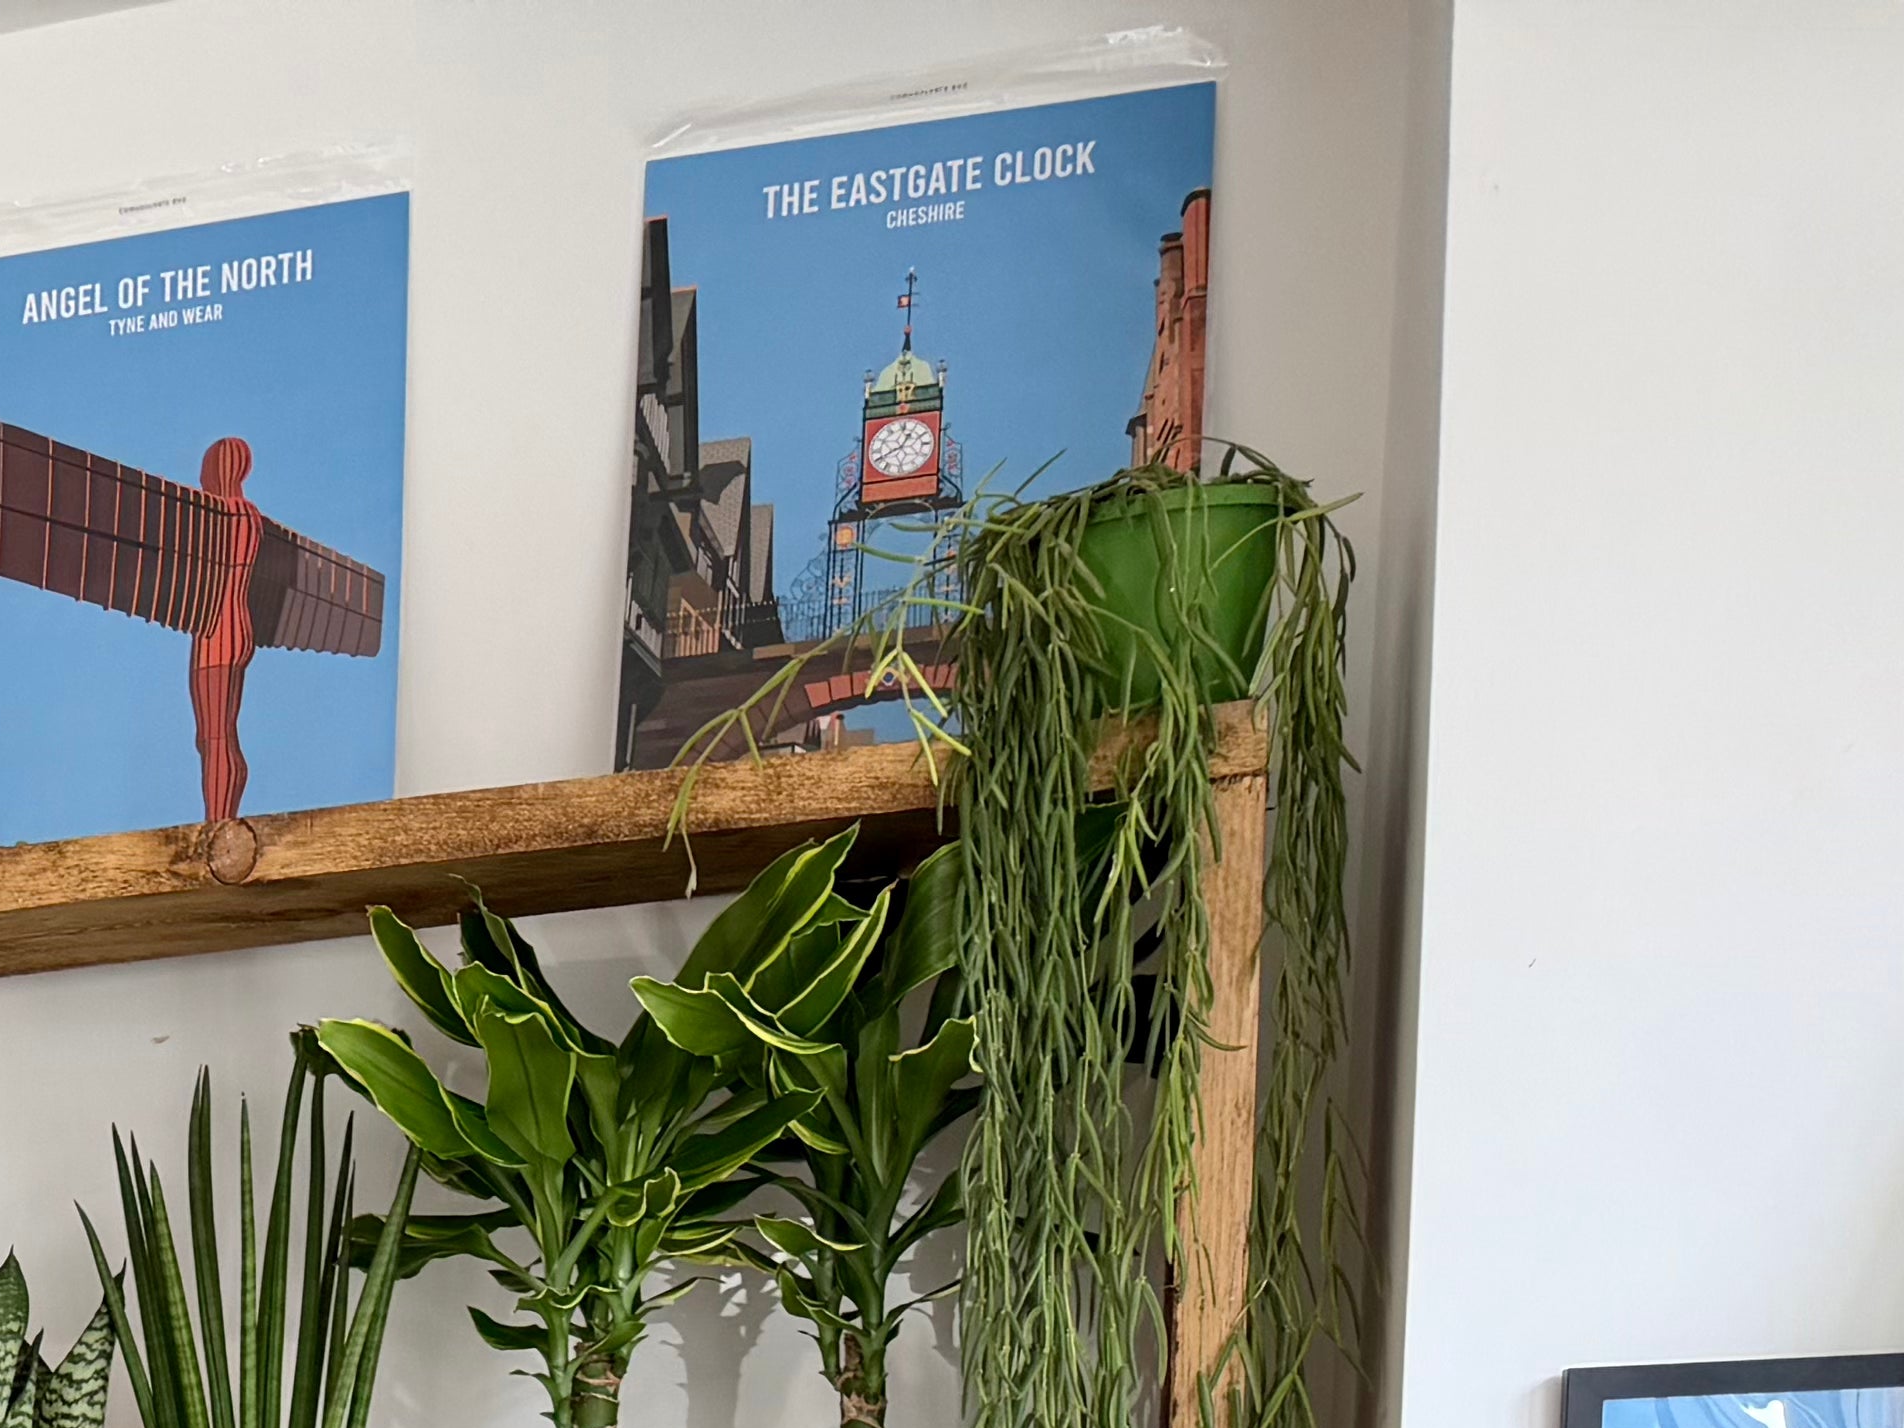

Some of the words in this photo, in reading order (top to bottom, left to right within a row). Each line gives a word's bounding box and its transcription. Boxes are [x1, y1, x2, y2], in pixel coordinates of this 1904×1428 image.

[763, 180, 820, 218] THE
[830, 156, 984, 210] EASTGATE
[994, 140, 1097, 186] CLOCK
[886, 201, 966, 229] CHESHIRE
[22, 283, 108, 325] ANGEL
[118, 275, 152, 309] OF
[160, 265, 212, 302] THE
[221, 249, 313, 294] NORTH
[108, 316, 145, 337] TYNE
[148, 309, 178, 330] AND
[182, 304, 223, 326] WEAR
